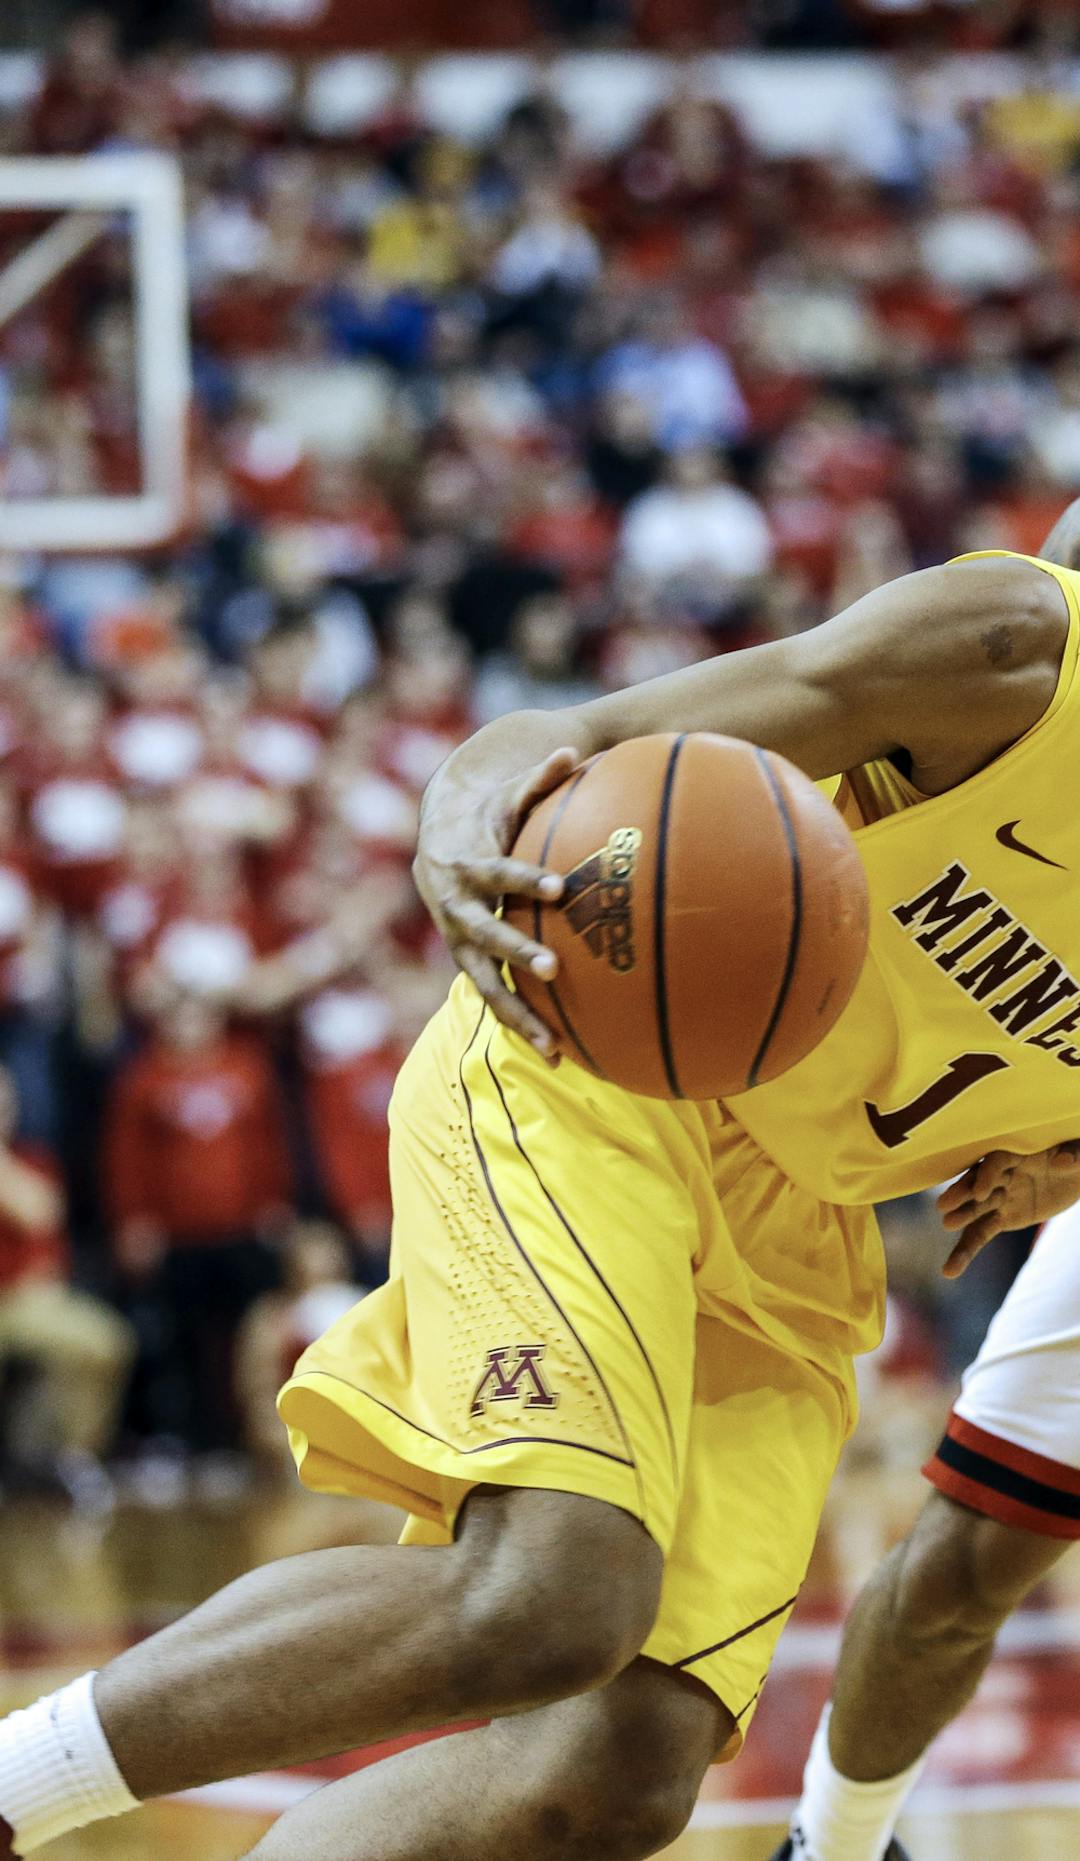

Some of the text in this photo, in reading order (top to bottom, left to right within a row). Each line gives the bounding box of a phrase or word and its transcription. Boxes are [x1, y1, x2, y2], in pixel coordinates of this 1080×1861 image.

[602, 826, 643, 974] adidas
[865, 1050, 1015, 1149] 1
[469, 1344, 560, 1418] M
